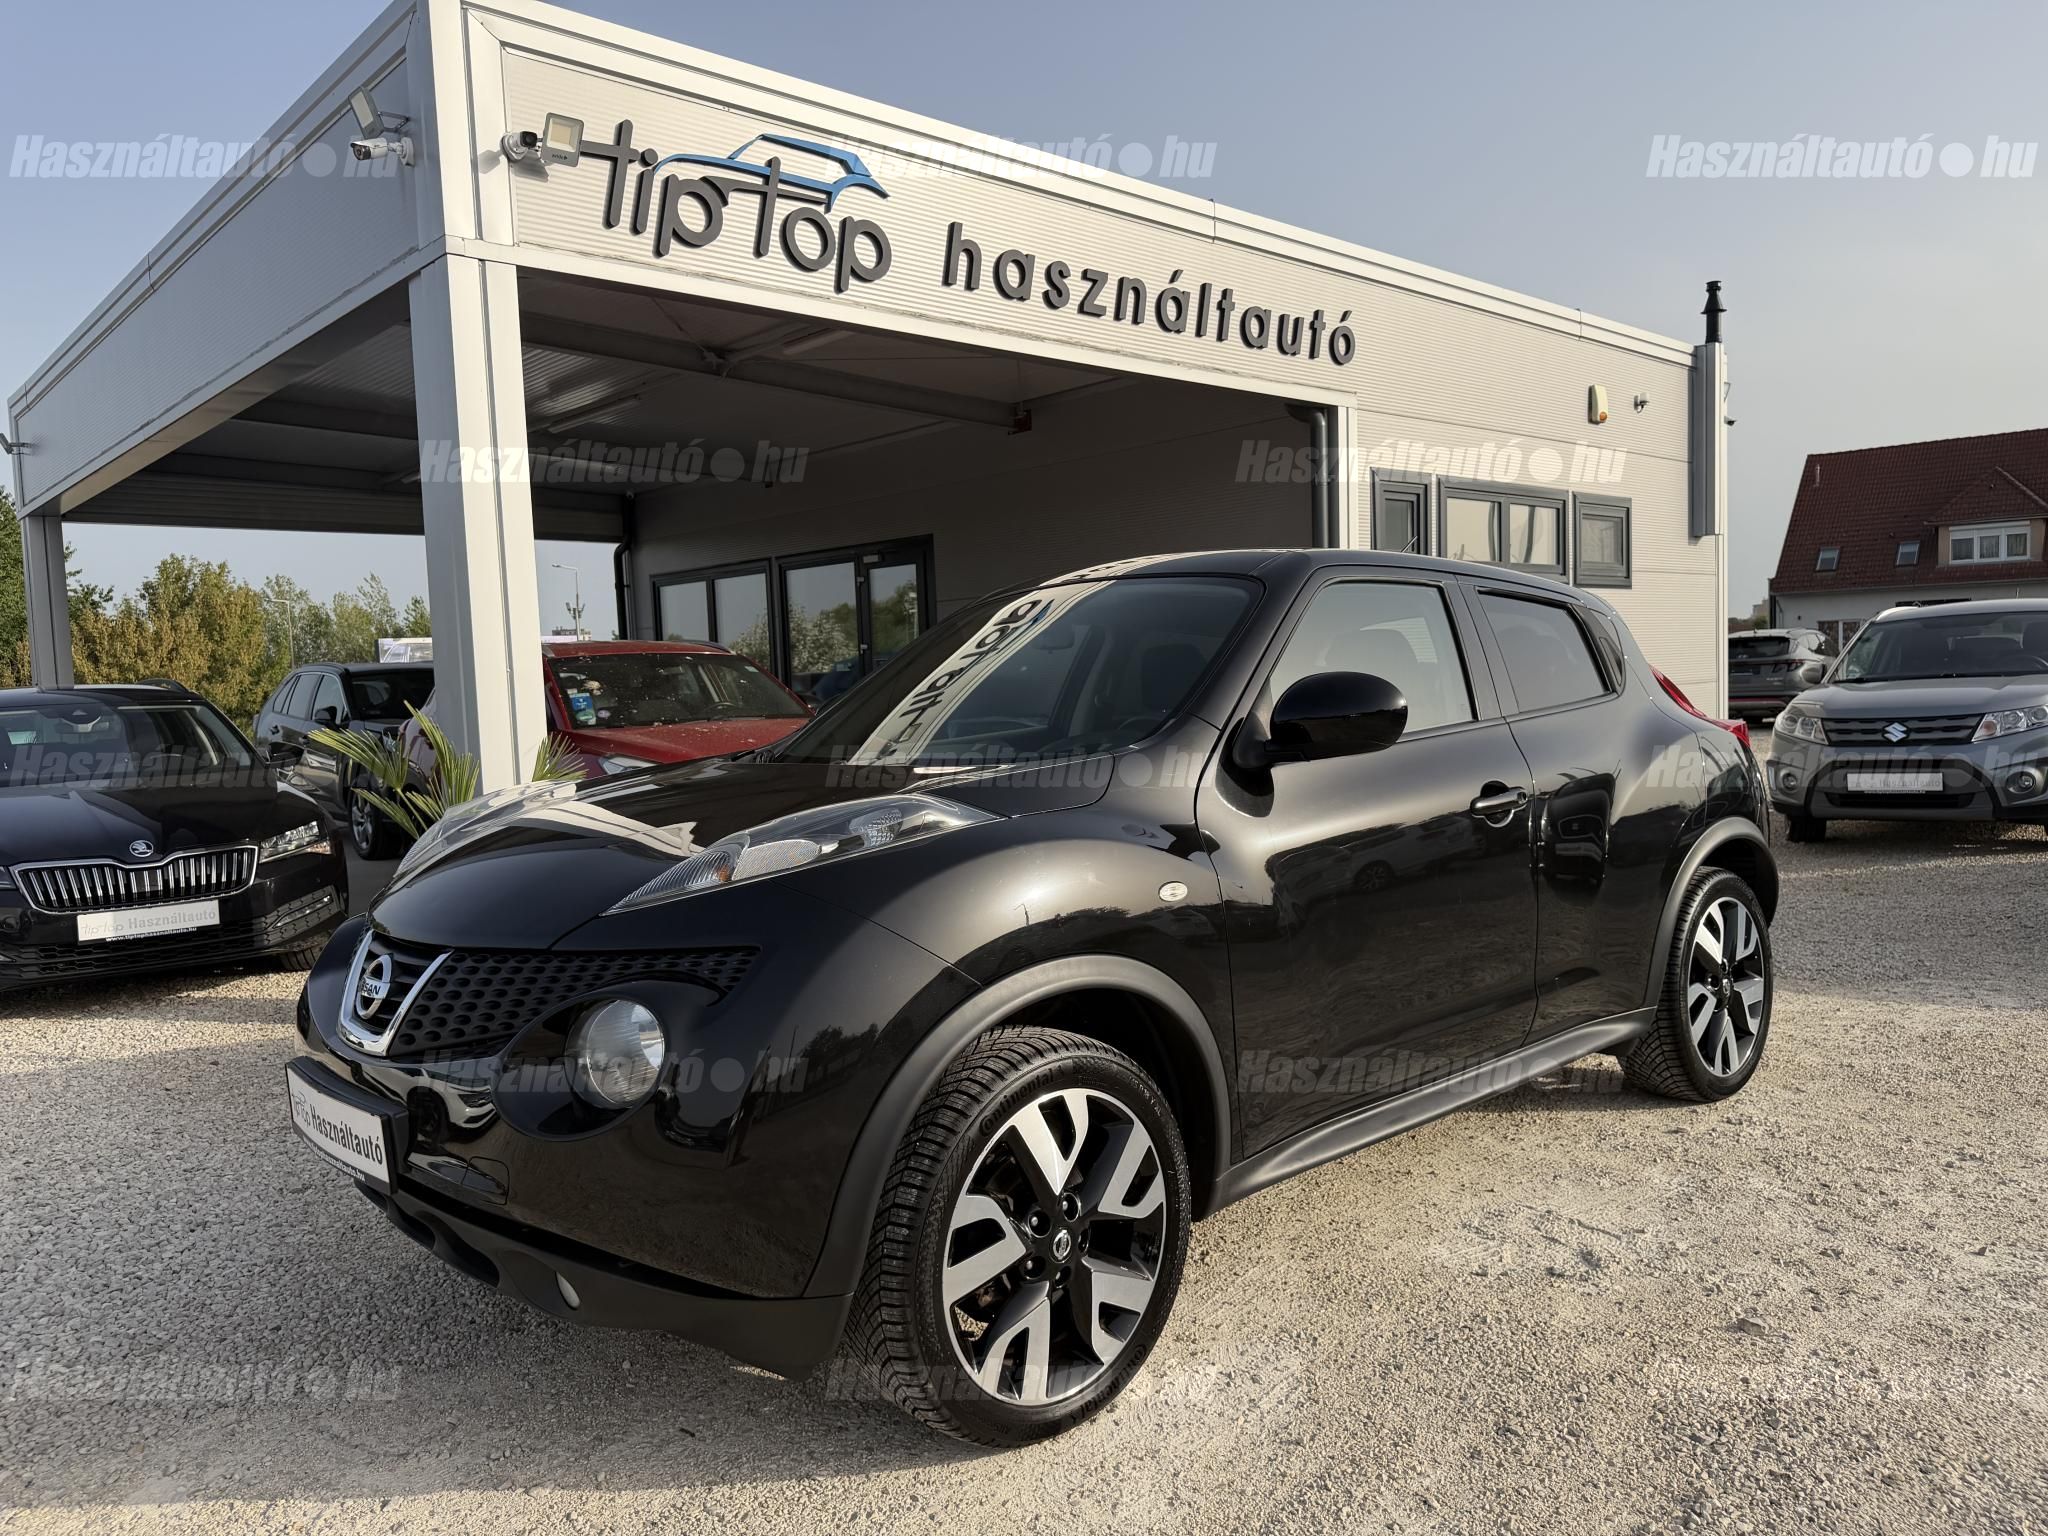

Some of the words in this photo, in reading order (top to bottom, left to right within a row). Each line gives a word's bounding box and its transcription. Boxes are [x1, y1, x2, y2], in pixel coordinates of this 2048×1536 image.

[942, 221, 1356, 366] használtautó
[309, 1103, 383, 1165] Használtautó
[979, 1066, 1055, 1137] Continental
